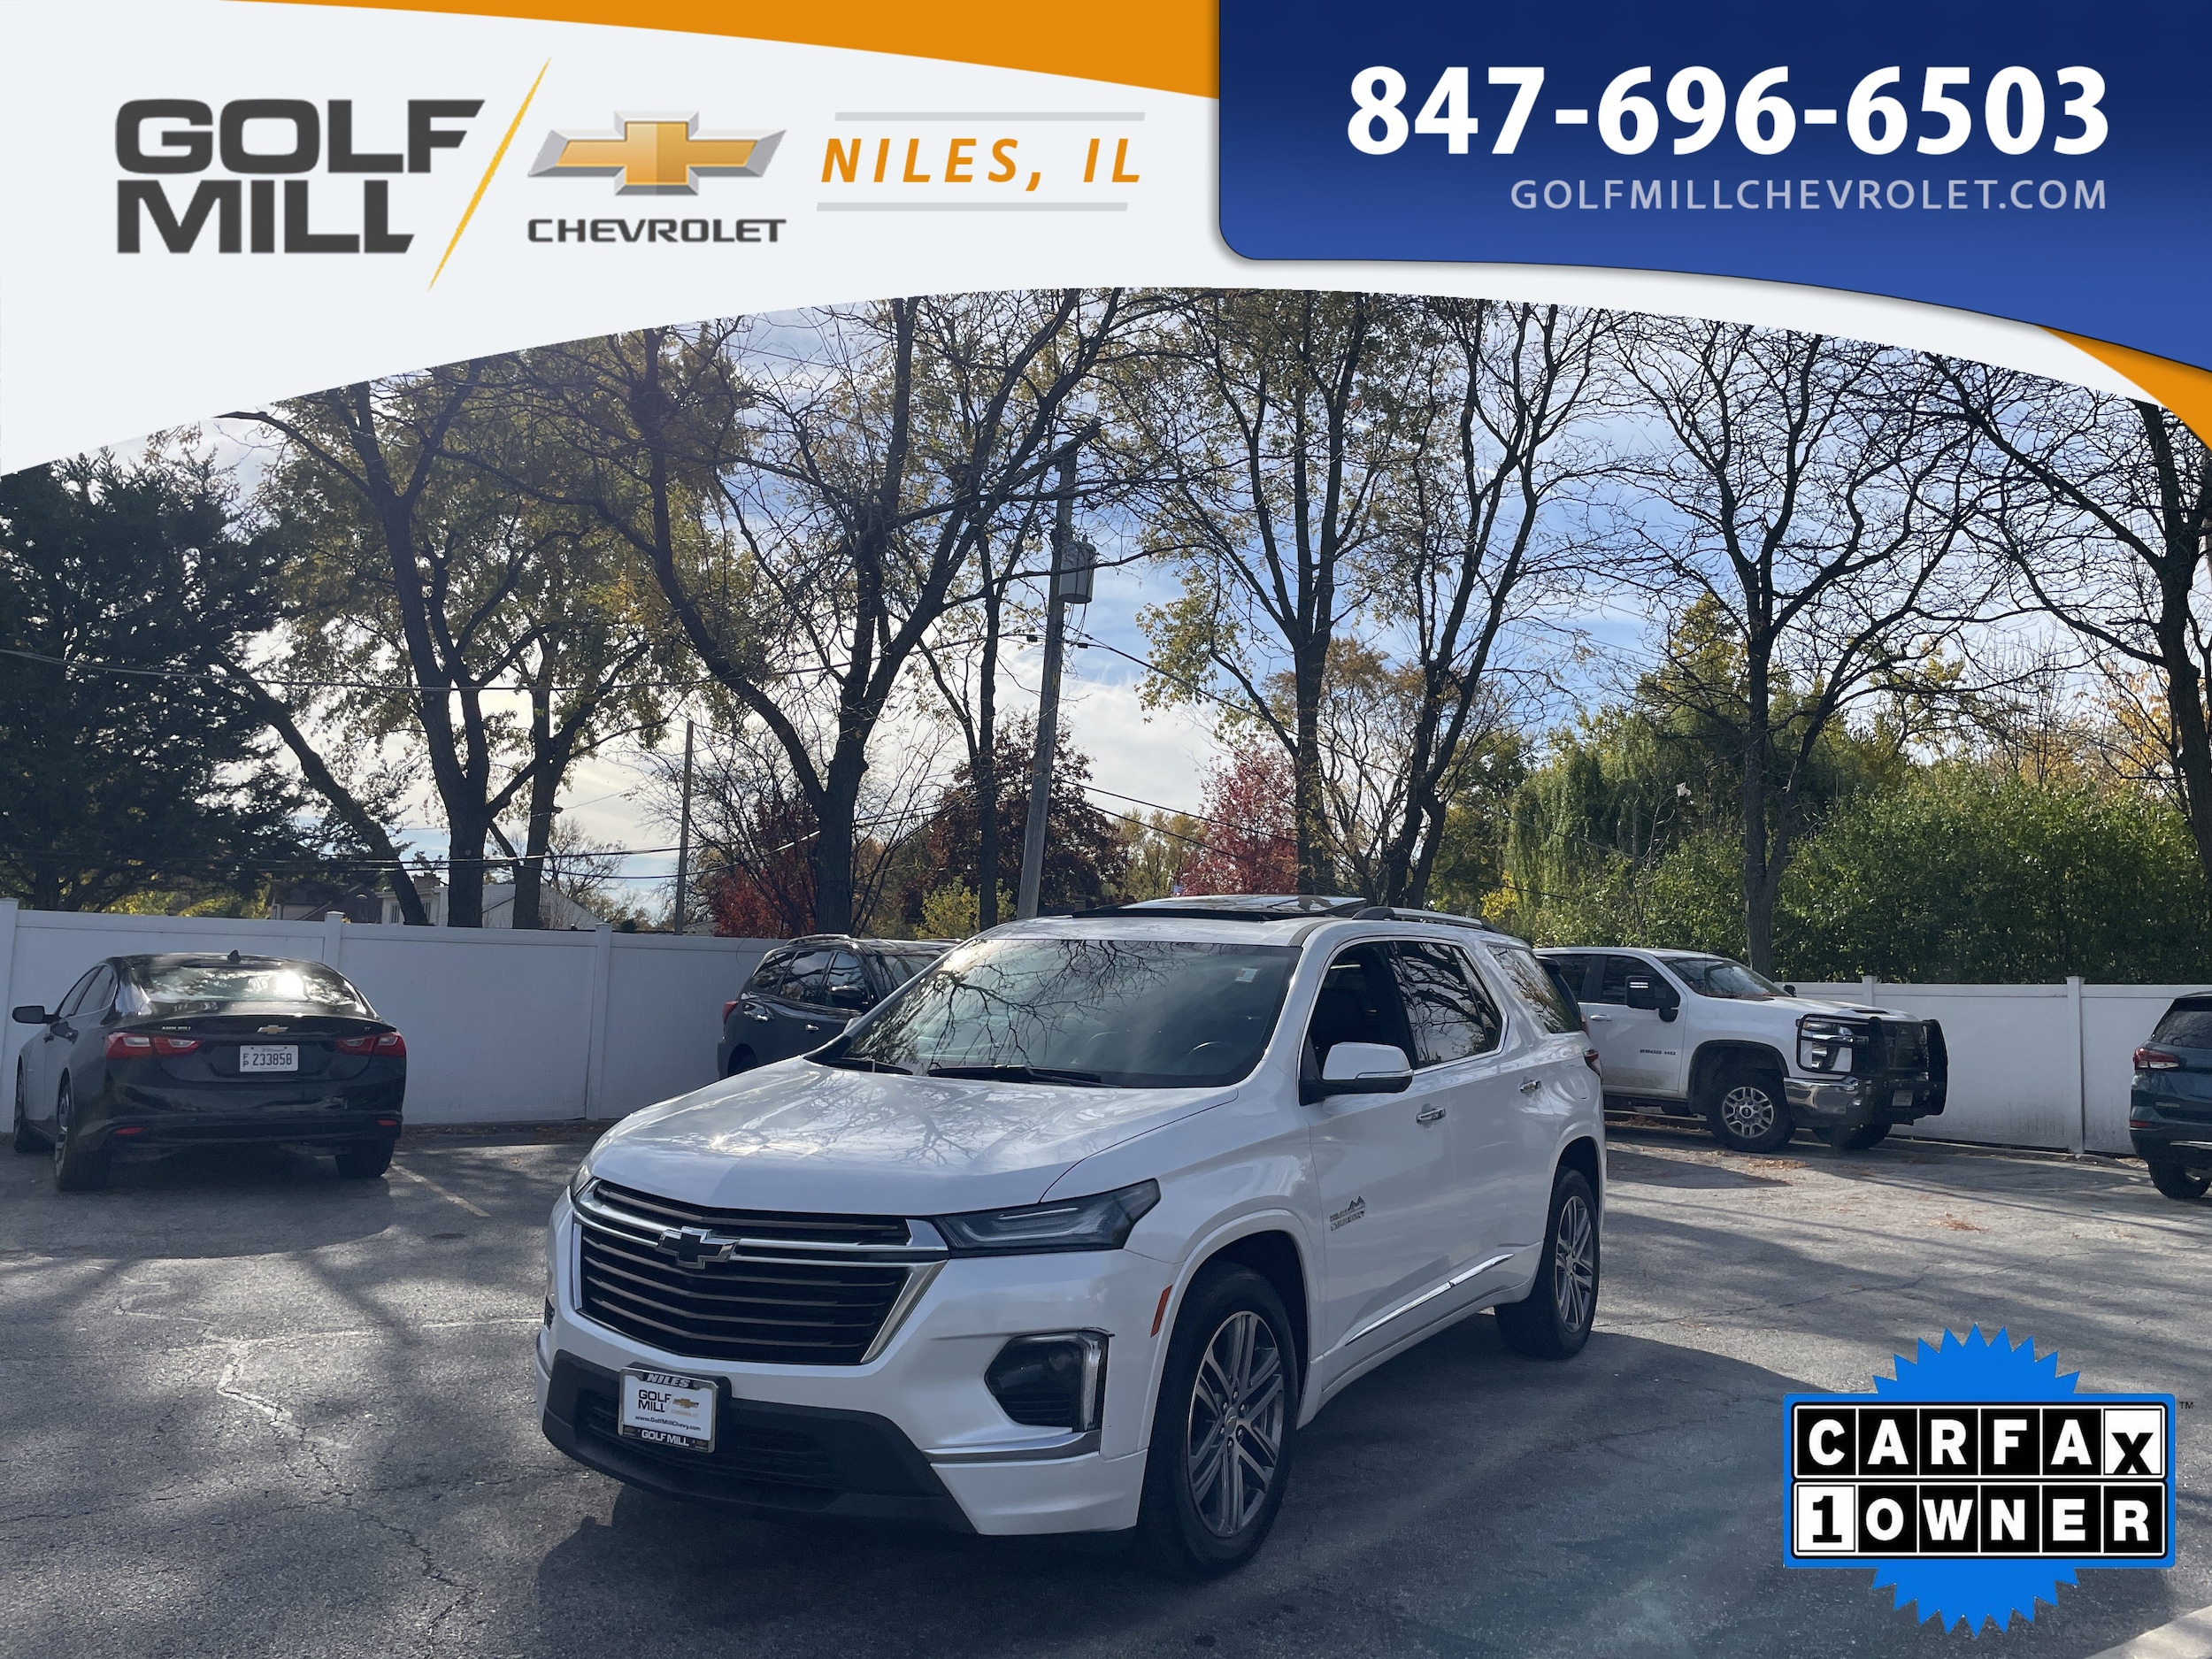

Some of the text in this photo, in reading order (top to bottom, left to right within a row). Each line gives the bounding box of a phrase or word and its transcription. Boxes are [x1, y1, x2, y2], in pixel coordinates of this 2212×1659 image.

[252, 1053, 293, 1066] 233858
[646, 1373, 691, 1388] NILES
[638, 1389, 672, 1403] GOLF
[638, 1399, 665, 1413] MILL
[641, 1429, 690, 1448] GOLF MILL
